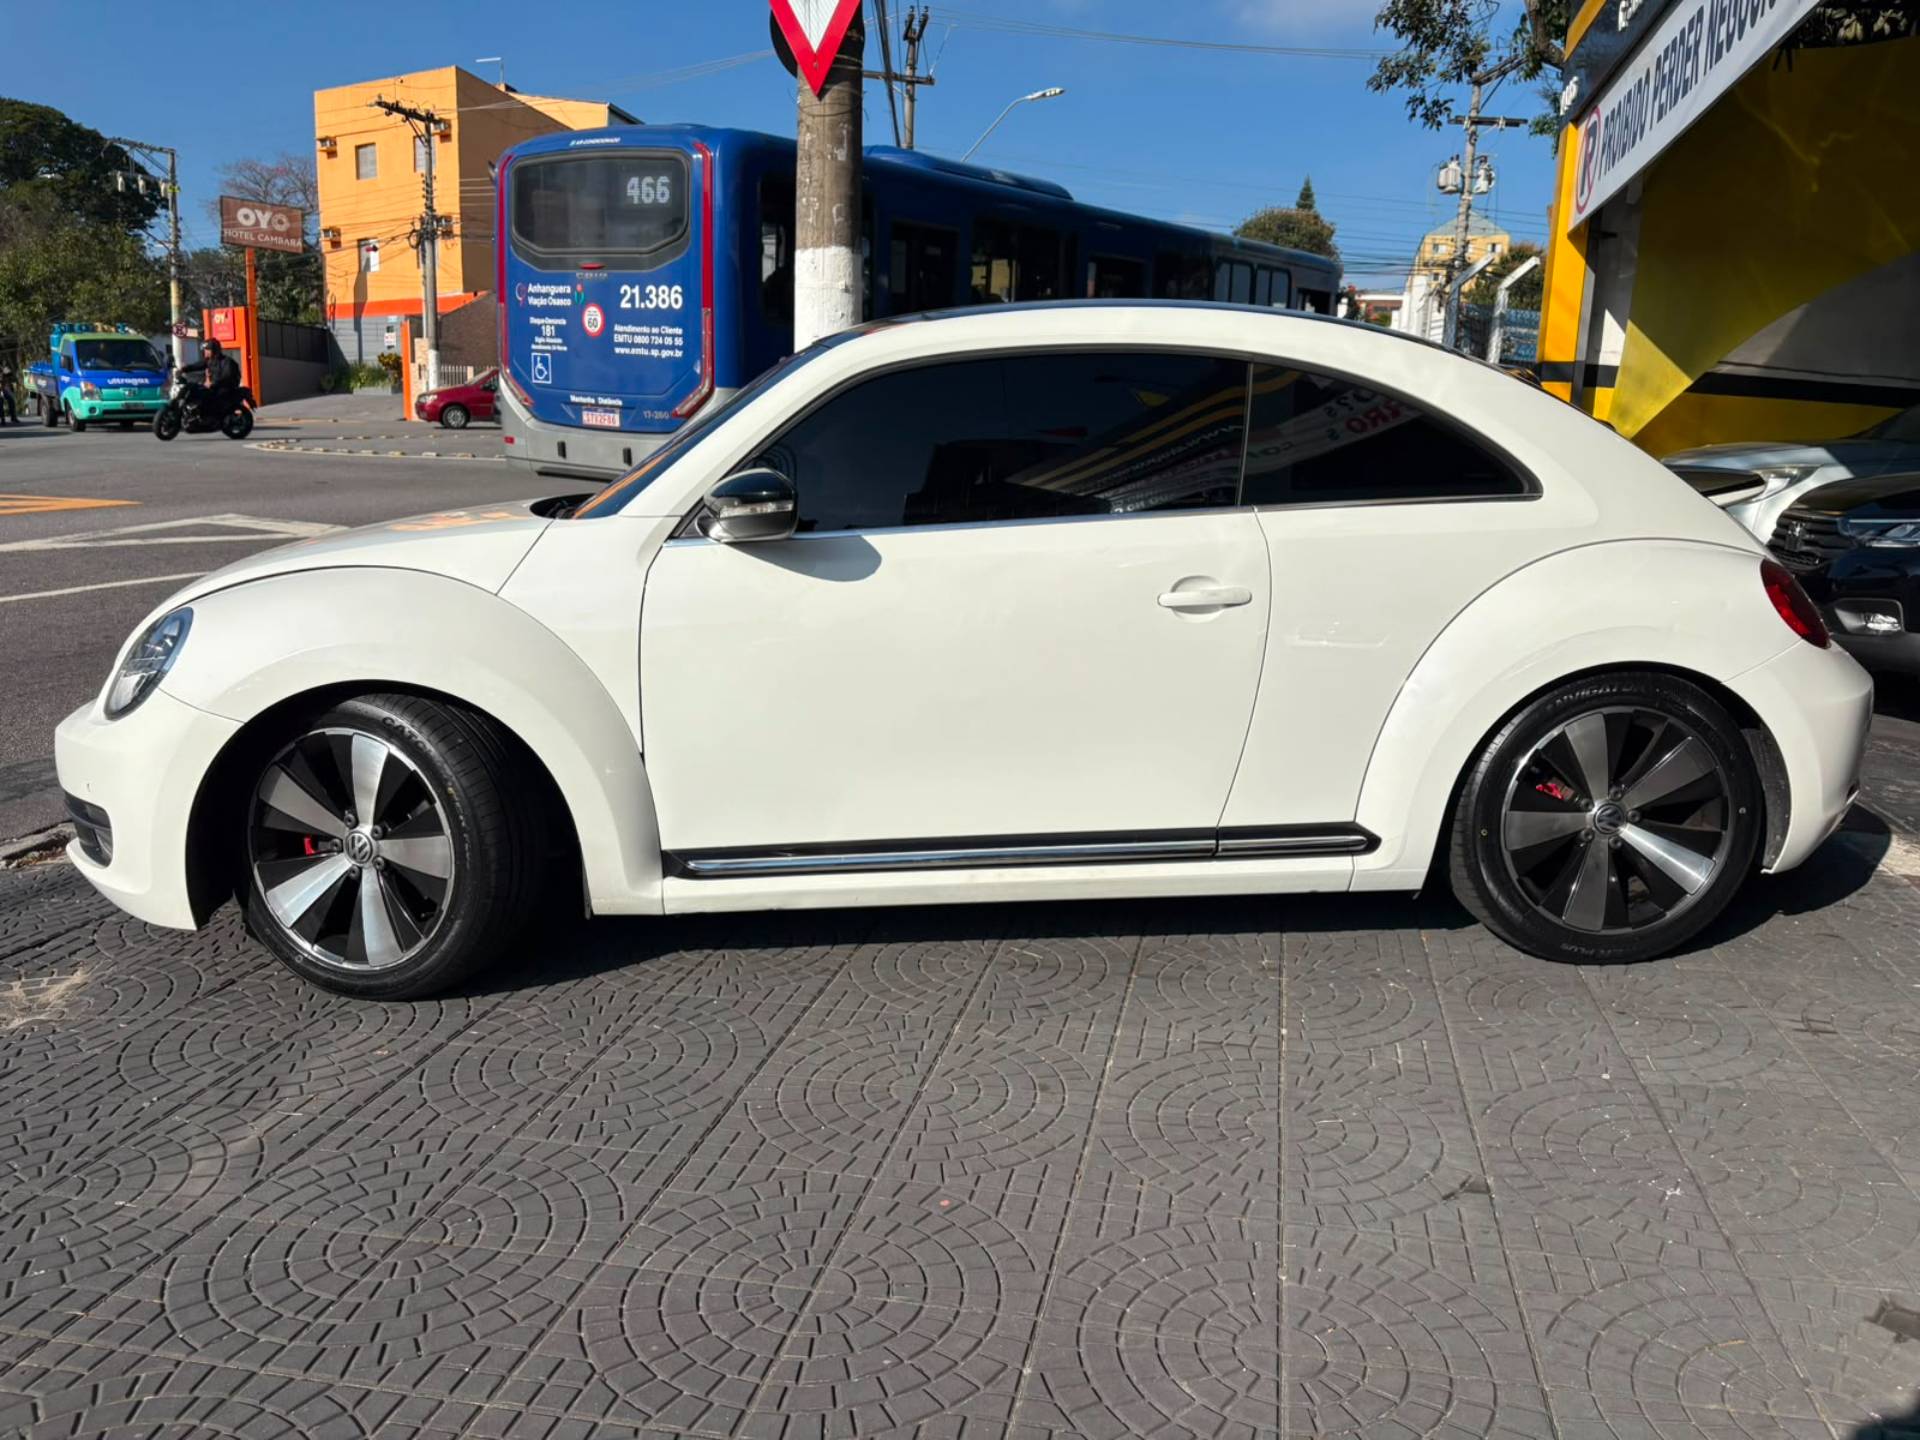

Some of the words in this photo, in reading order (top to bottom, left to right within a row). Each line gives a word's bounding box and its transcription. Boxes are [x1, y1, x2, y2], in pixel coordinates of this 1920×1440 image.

[1597, 66, 1650, 181] PROIBIDO
[1649, 4, 1704, 131] PERDER
[1703, 0, 1776, 76] NEGO
[626, 176, 671, 205] 466
[236, 207, 290, 232] OYO
[224, 229, 255, 241] HOTEL
[528, 283, 571, 295] Anhanguera
[548, 296, 571, 306] Osasco
[620, 285, 683, 309] 21.386
[588, 317, 599, 329] 60
[541, 325, 556, 337] 181
[614, 324, 650, 334] Atendimento
[660, 326, 683, 335] Cliente
[614, 334, 632, 344] EMTU
[634, 335, 650, 344] 0800
[651, 336, 663, 345] 724
[614, 347, 684, 359] www.emtu.sp.gov.br
